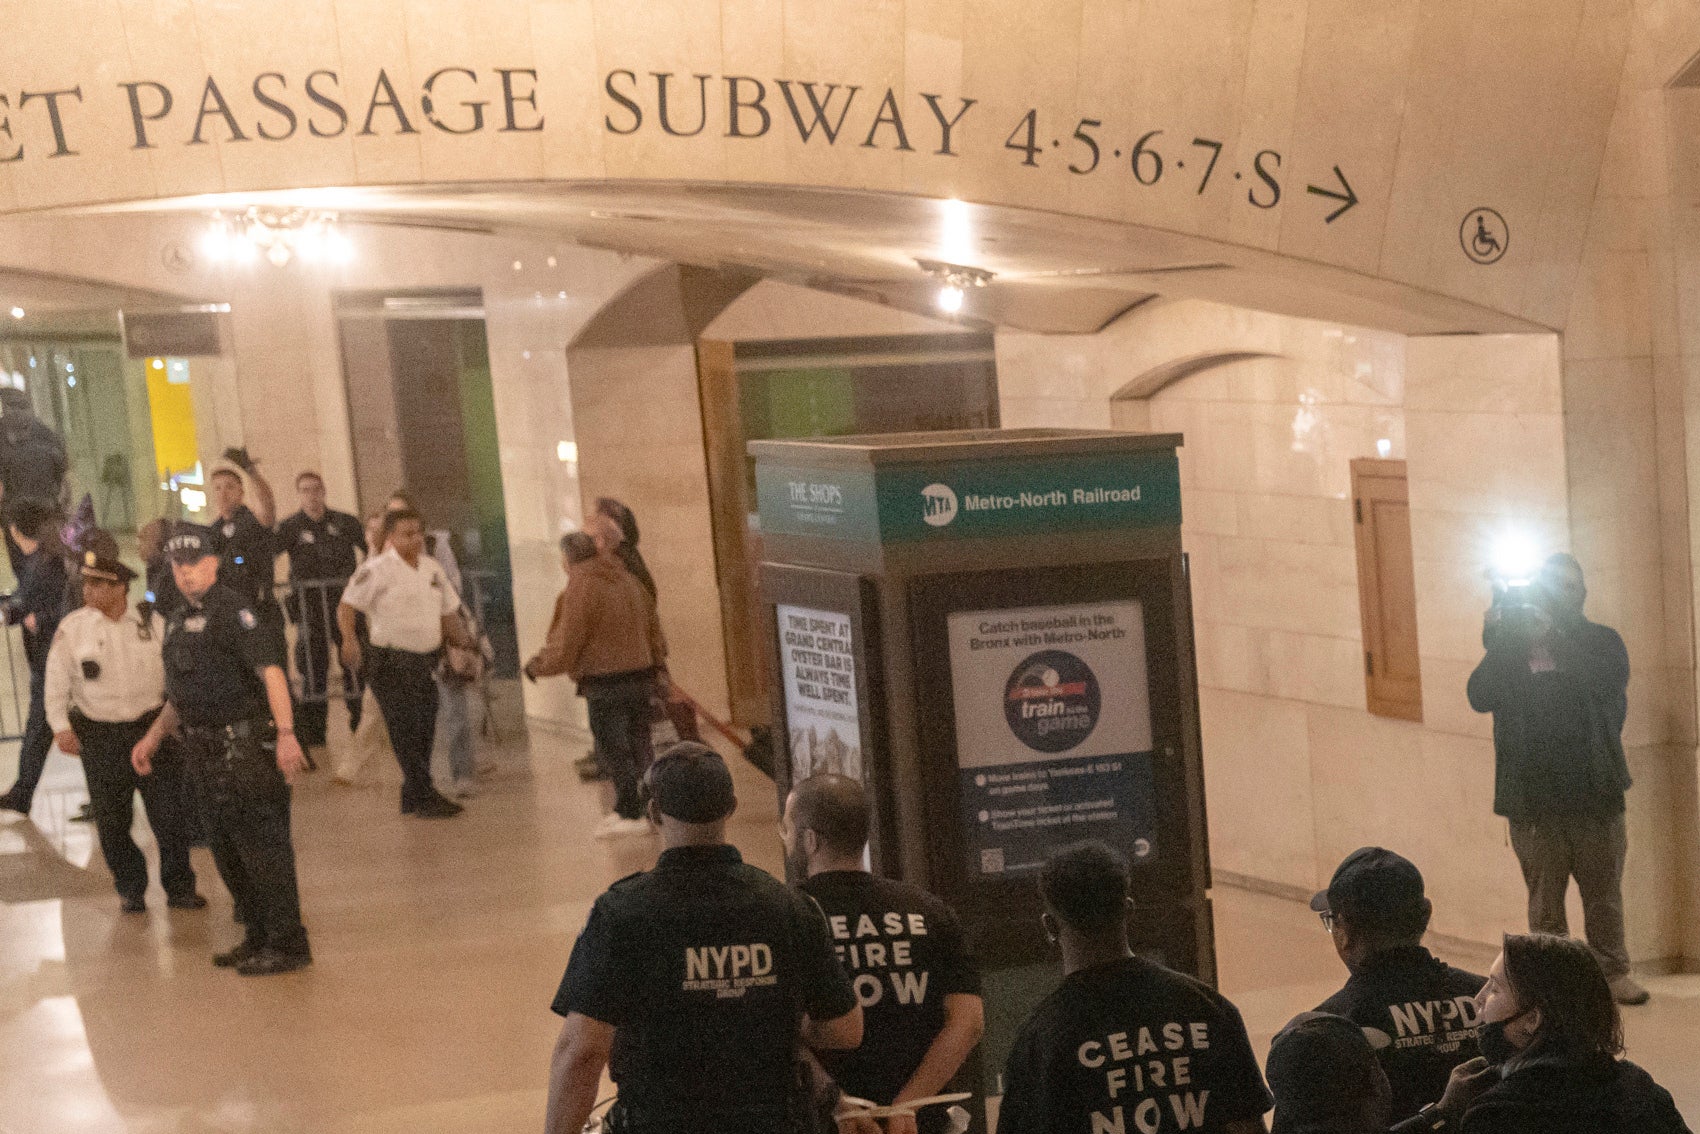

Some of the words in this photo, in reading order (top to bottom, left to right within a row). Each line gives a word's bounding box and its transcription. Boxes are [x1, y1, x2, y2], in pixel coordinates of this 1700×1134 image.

[118, 68, 545, 148] PASSAGE
[605, 69, 979, 156] SUBWAY
[788, 482, 807, 502] THE
[809, 483, 842, 505] SHOPS
[965, 490, 1067, 511] Metro-North
[1073, 486, 1141, 504] Railroad
[979, 620, 1019, 635] Catch
[1021, 615, 1077, 631] baseball
[1079, 614, 1092, 626] in
[1093, 613, 1115, 625] the
[817, 636, 851, 655] CENTRA
[970, 637, 1010, 651] Bronx
[1014, 633, 1041, 647] with
[1044, 627, 1126, 644] Metro-North
[1022, 698, 1065, 719] train
[1037, 715, 1091, 737] game
[830, 911, 928, 940] EASE
[685, 942, 774, 981] NYPD
[852, 970, 930, 1008] OW
[1388, 995, 1482, 1038] NYPD
[1078, 1021, 1210, 1069] CEASE
[1106, 1056, 1191, 1099] FIRE
